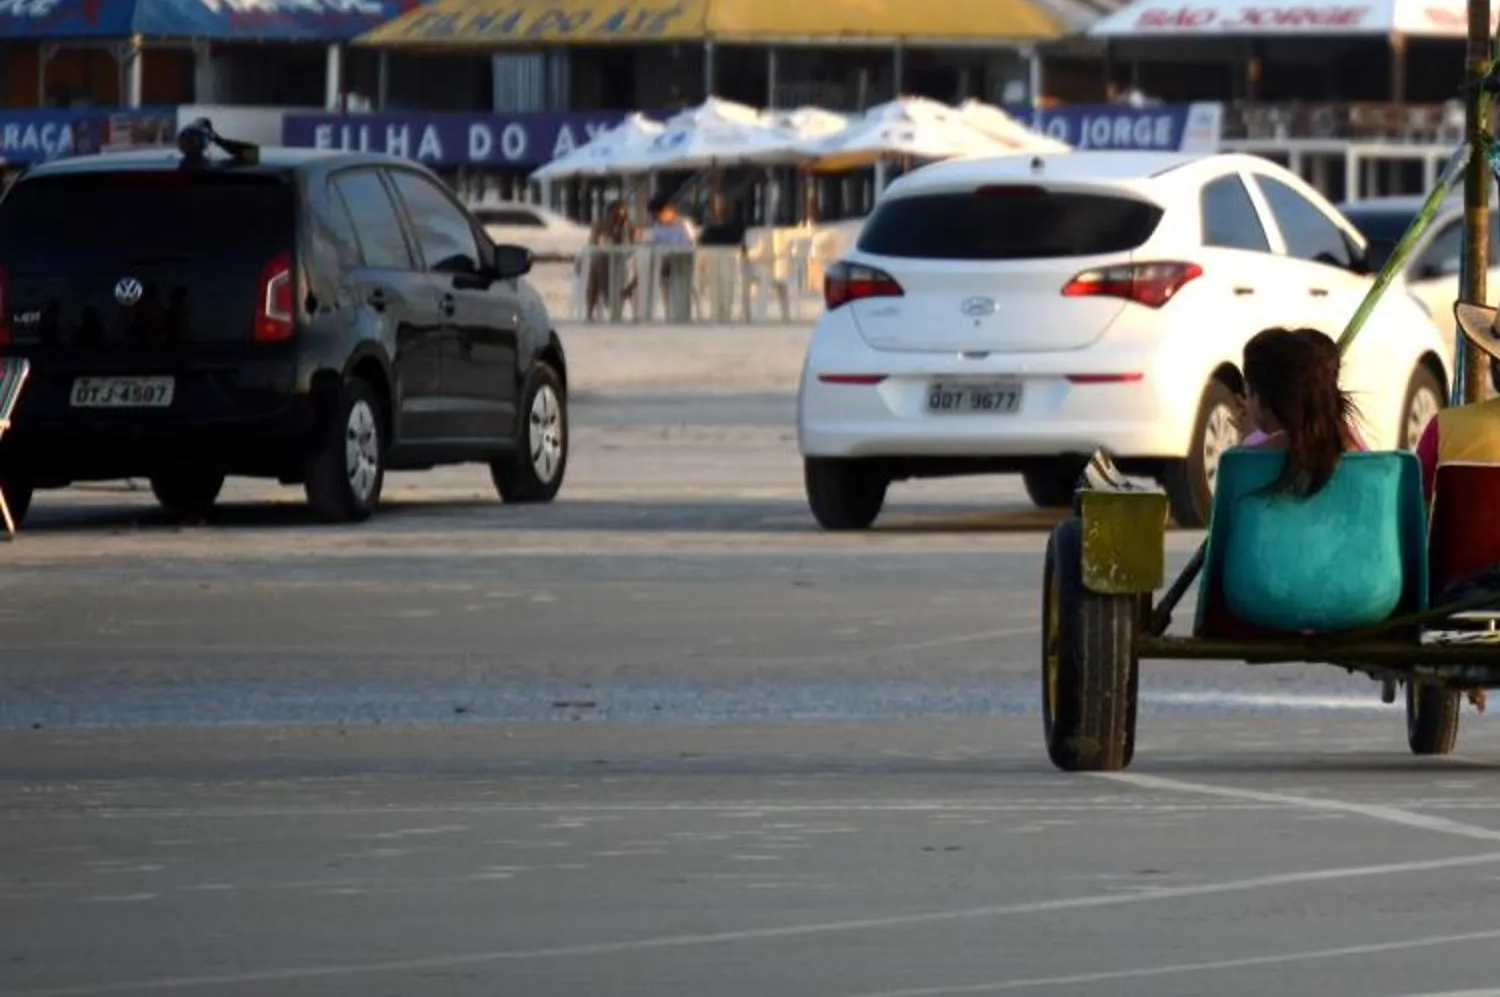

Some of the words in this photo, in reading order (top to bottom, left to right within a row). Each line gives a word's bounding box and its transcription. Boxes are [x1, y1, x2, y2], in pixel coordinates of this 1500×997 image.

[313, 123, 442, 160] FILHA
[468, 123, 527, 160] DO
[1078, 114, 1172, 150] JORGE
